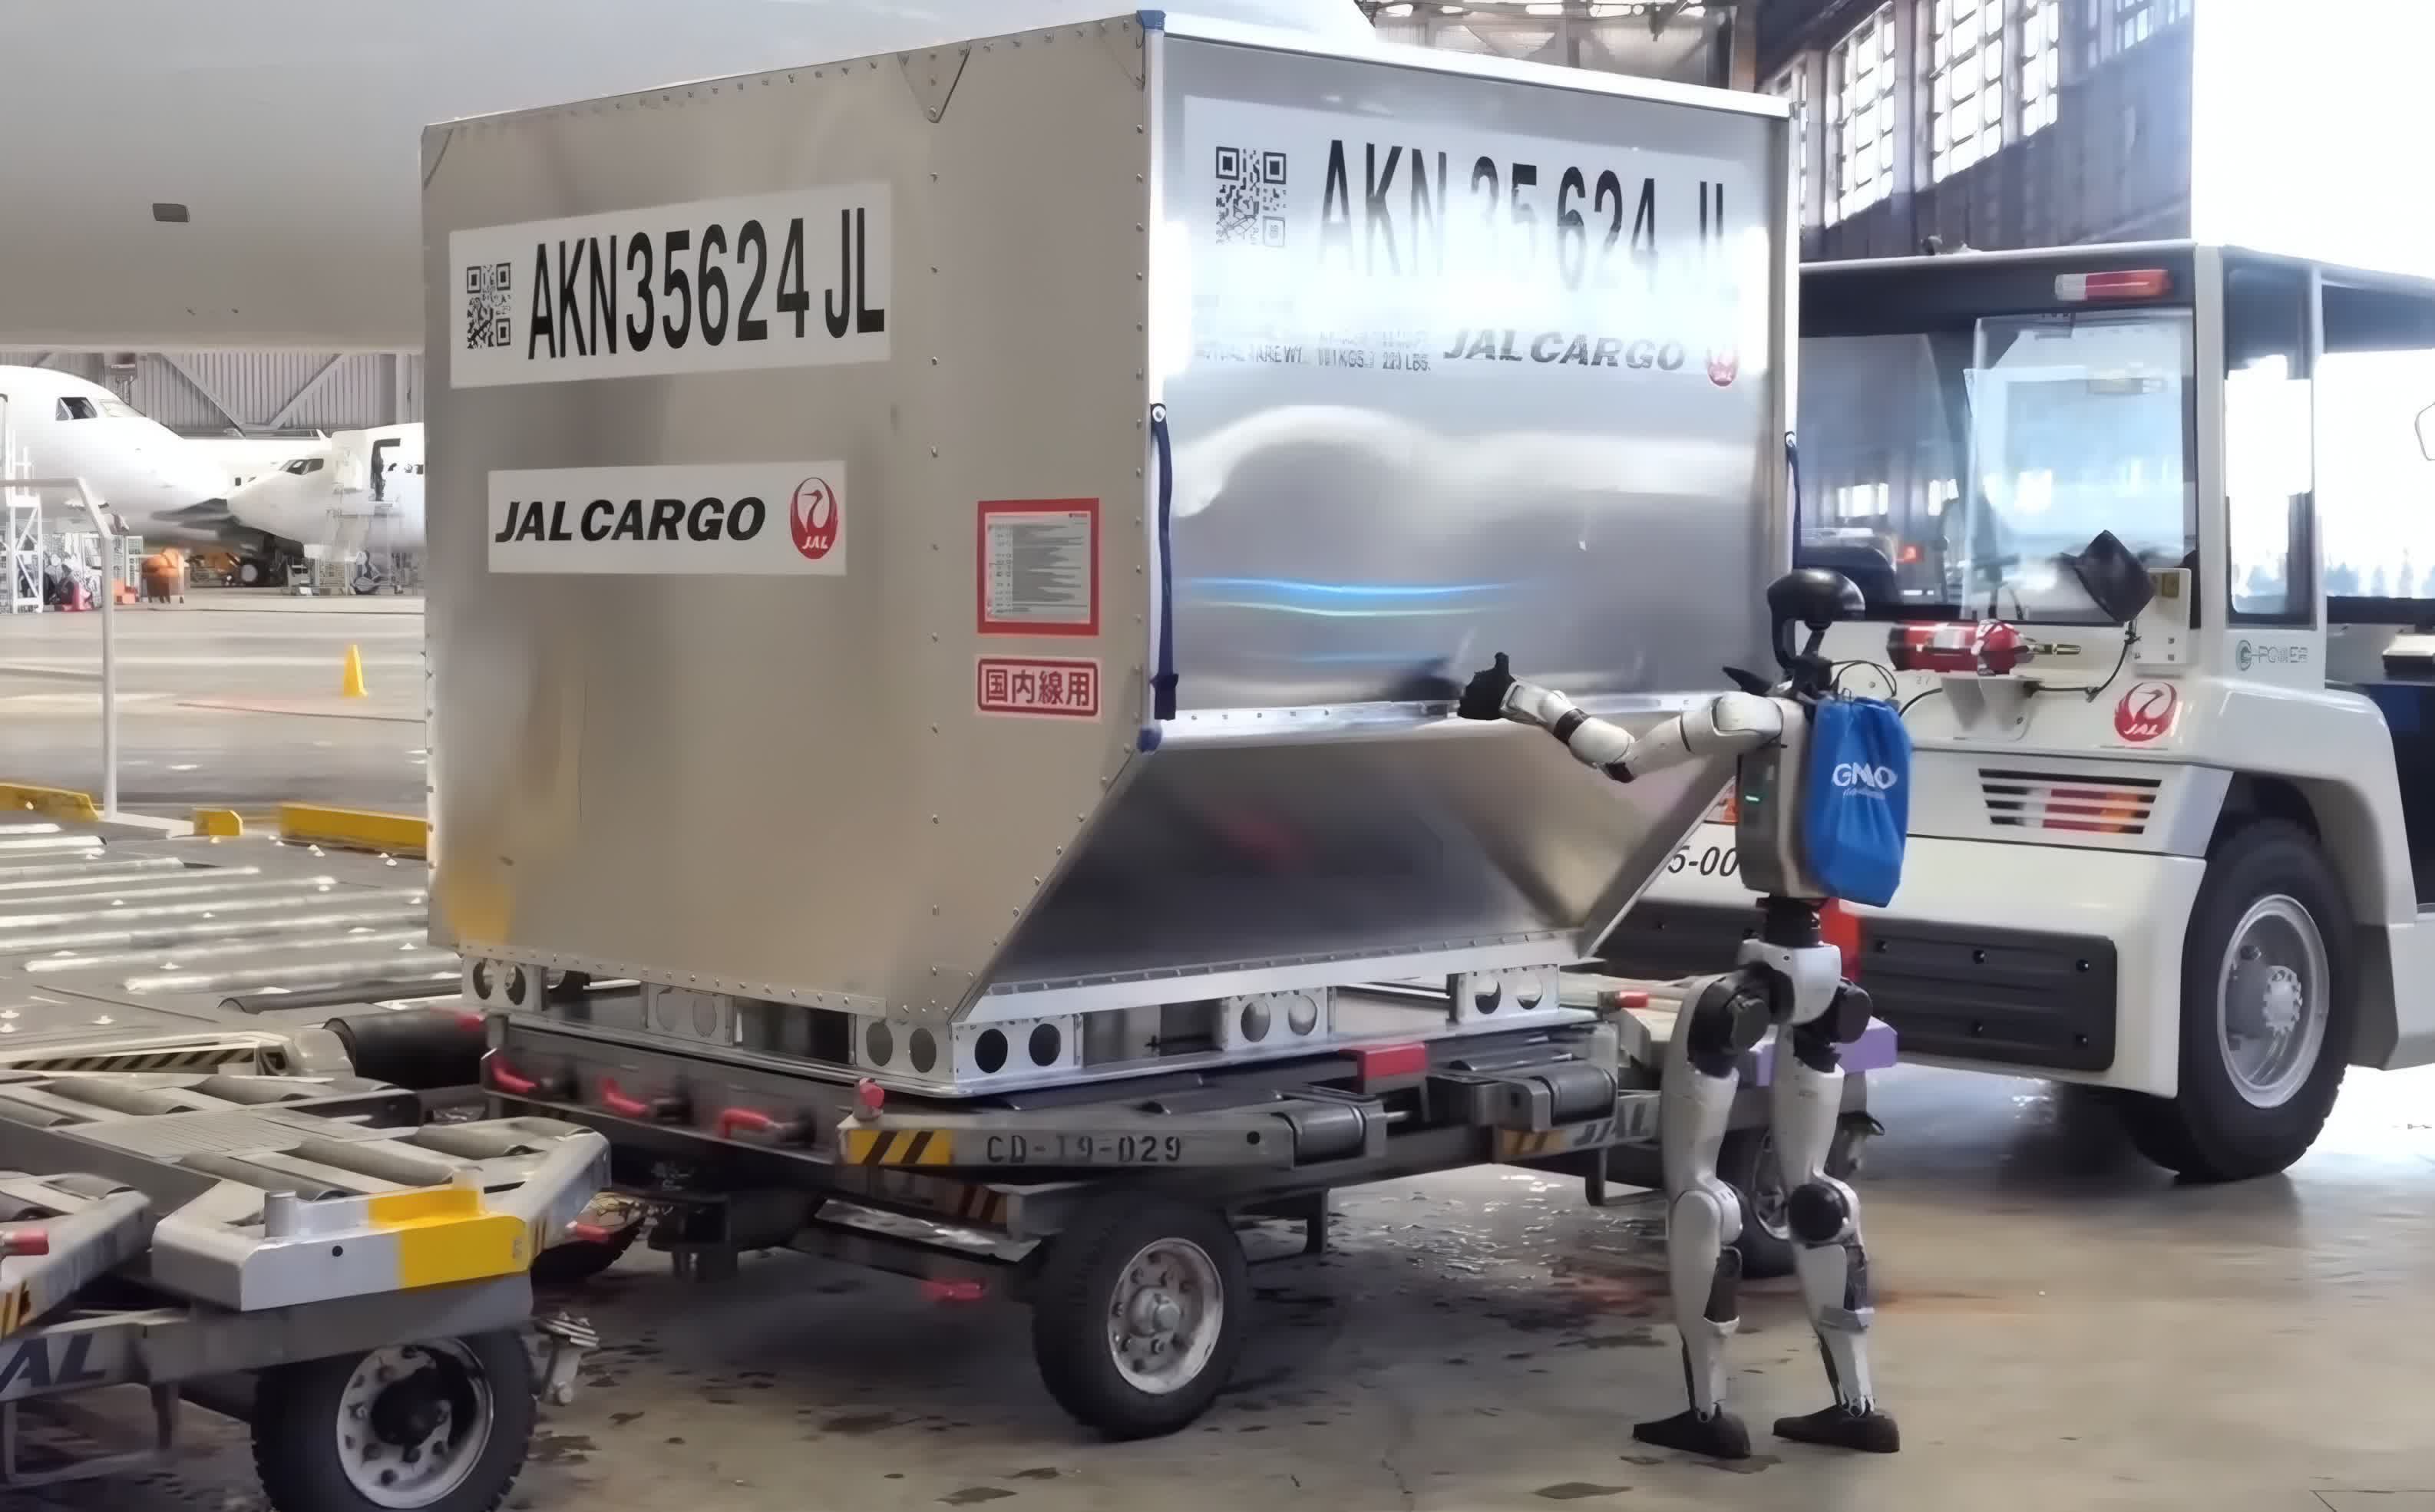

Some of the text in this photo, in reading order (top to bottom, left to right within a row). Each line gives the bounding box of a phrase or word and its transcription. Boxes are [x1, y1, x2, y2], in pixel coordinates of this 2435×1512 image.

[824, 207, 885, 338] JL
[1443, 328, 1523, 361] JAL
[1530, 331, 1686, 371] CARGO
[495, 496, 766, 543] JAL CARGO
[802, 536, 829, 550] JAL
[986, 669, 1090, 707] 国内線用
[2123, 724, 2159, 735] JAL
[1832, 761, 1898, 790] GMO
